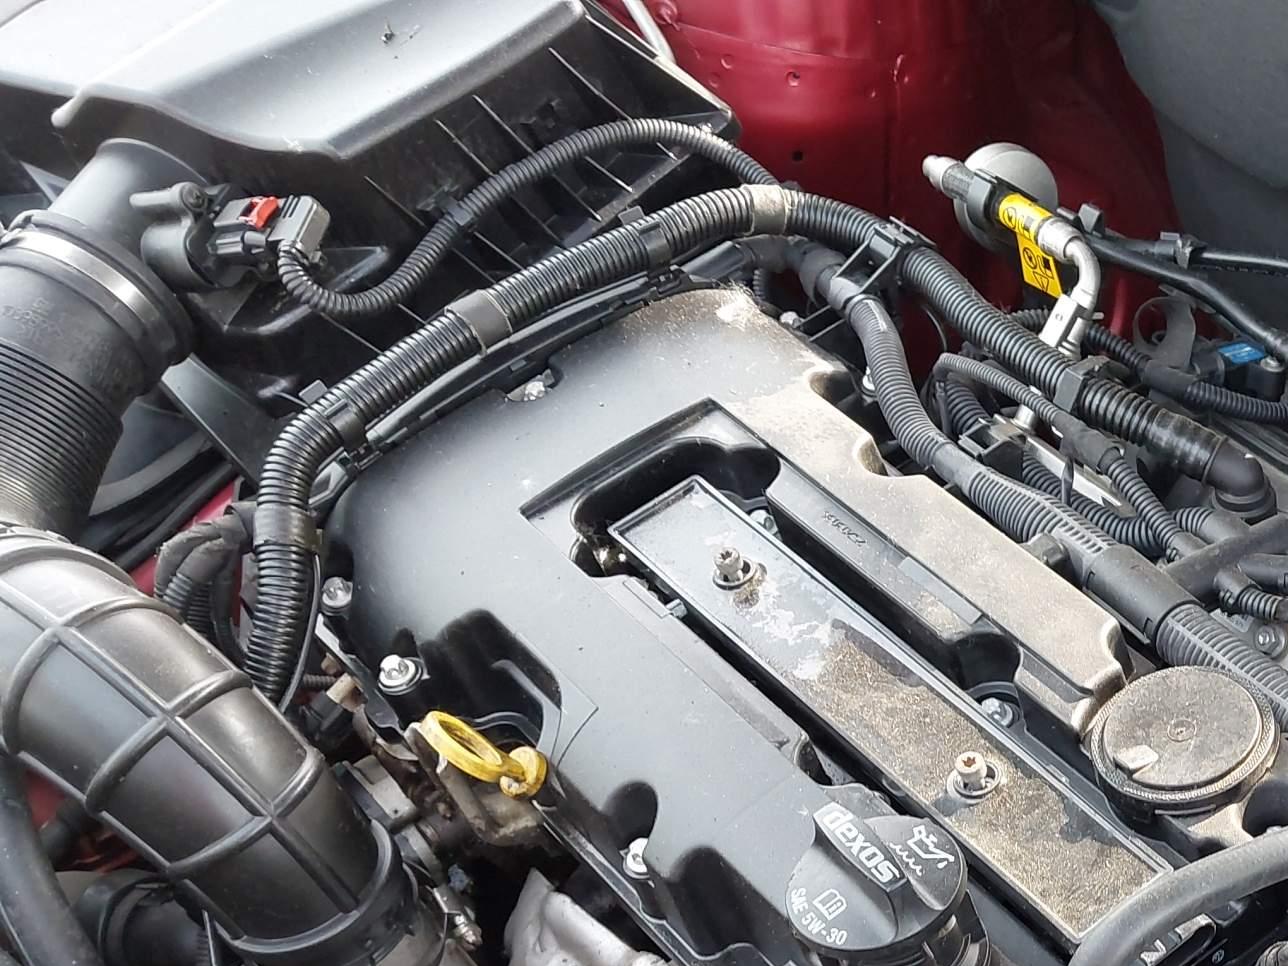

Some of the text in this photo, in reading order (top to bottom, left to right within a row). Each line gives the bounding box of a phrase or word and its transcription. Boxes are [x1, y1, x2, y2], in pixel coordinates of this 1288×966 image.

[822, 810, 901, 883] dexos
[791, 887, 848, 946] SAE 5W-30
